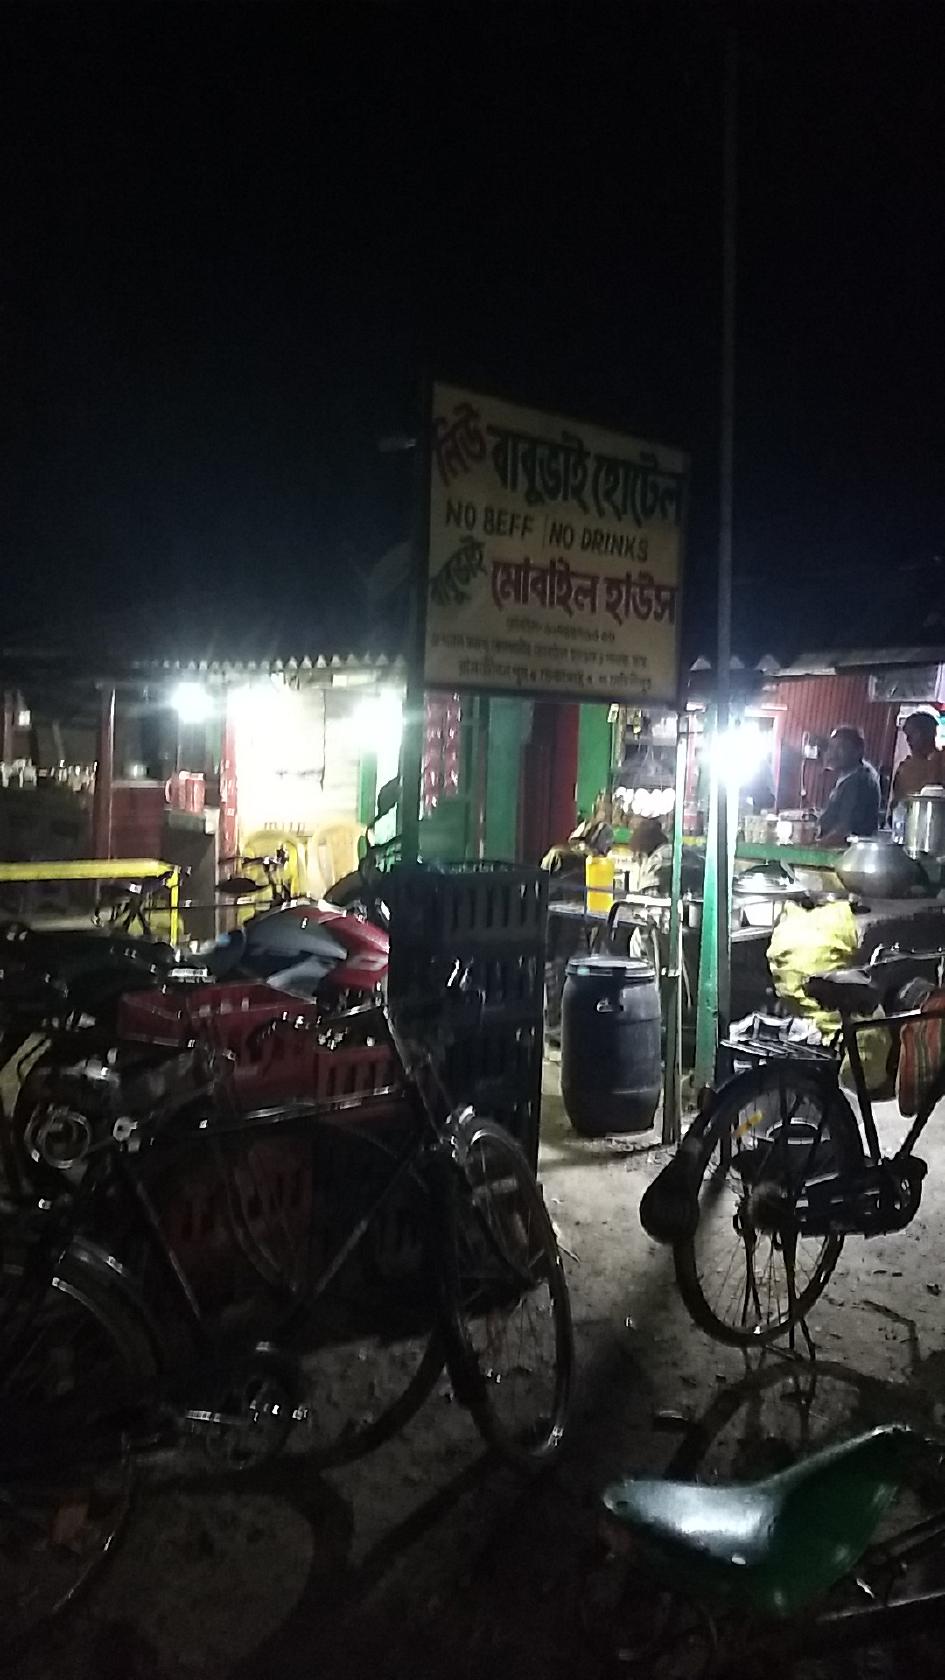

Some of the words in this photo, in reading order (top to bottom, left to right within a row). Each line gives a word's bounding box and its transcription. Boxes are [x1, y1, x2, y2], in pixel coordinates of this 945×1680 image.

[432, 402, 487, 487] নিউ
[592, 451, 688, 528] হোটেল
[446, 498, 476, 531] NO
[483, 506, 536, 541] BEFF
[549, 520, 575, 549] NO
[581, 526, 649, 563] DRINKS
[491, 555, 599, 617] মোবাইল
[602, 569, 679, 627] হাউস
